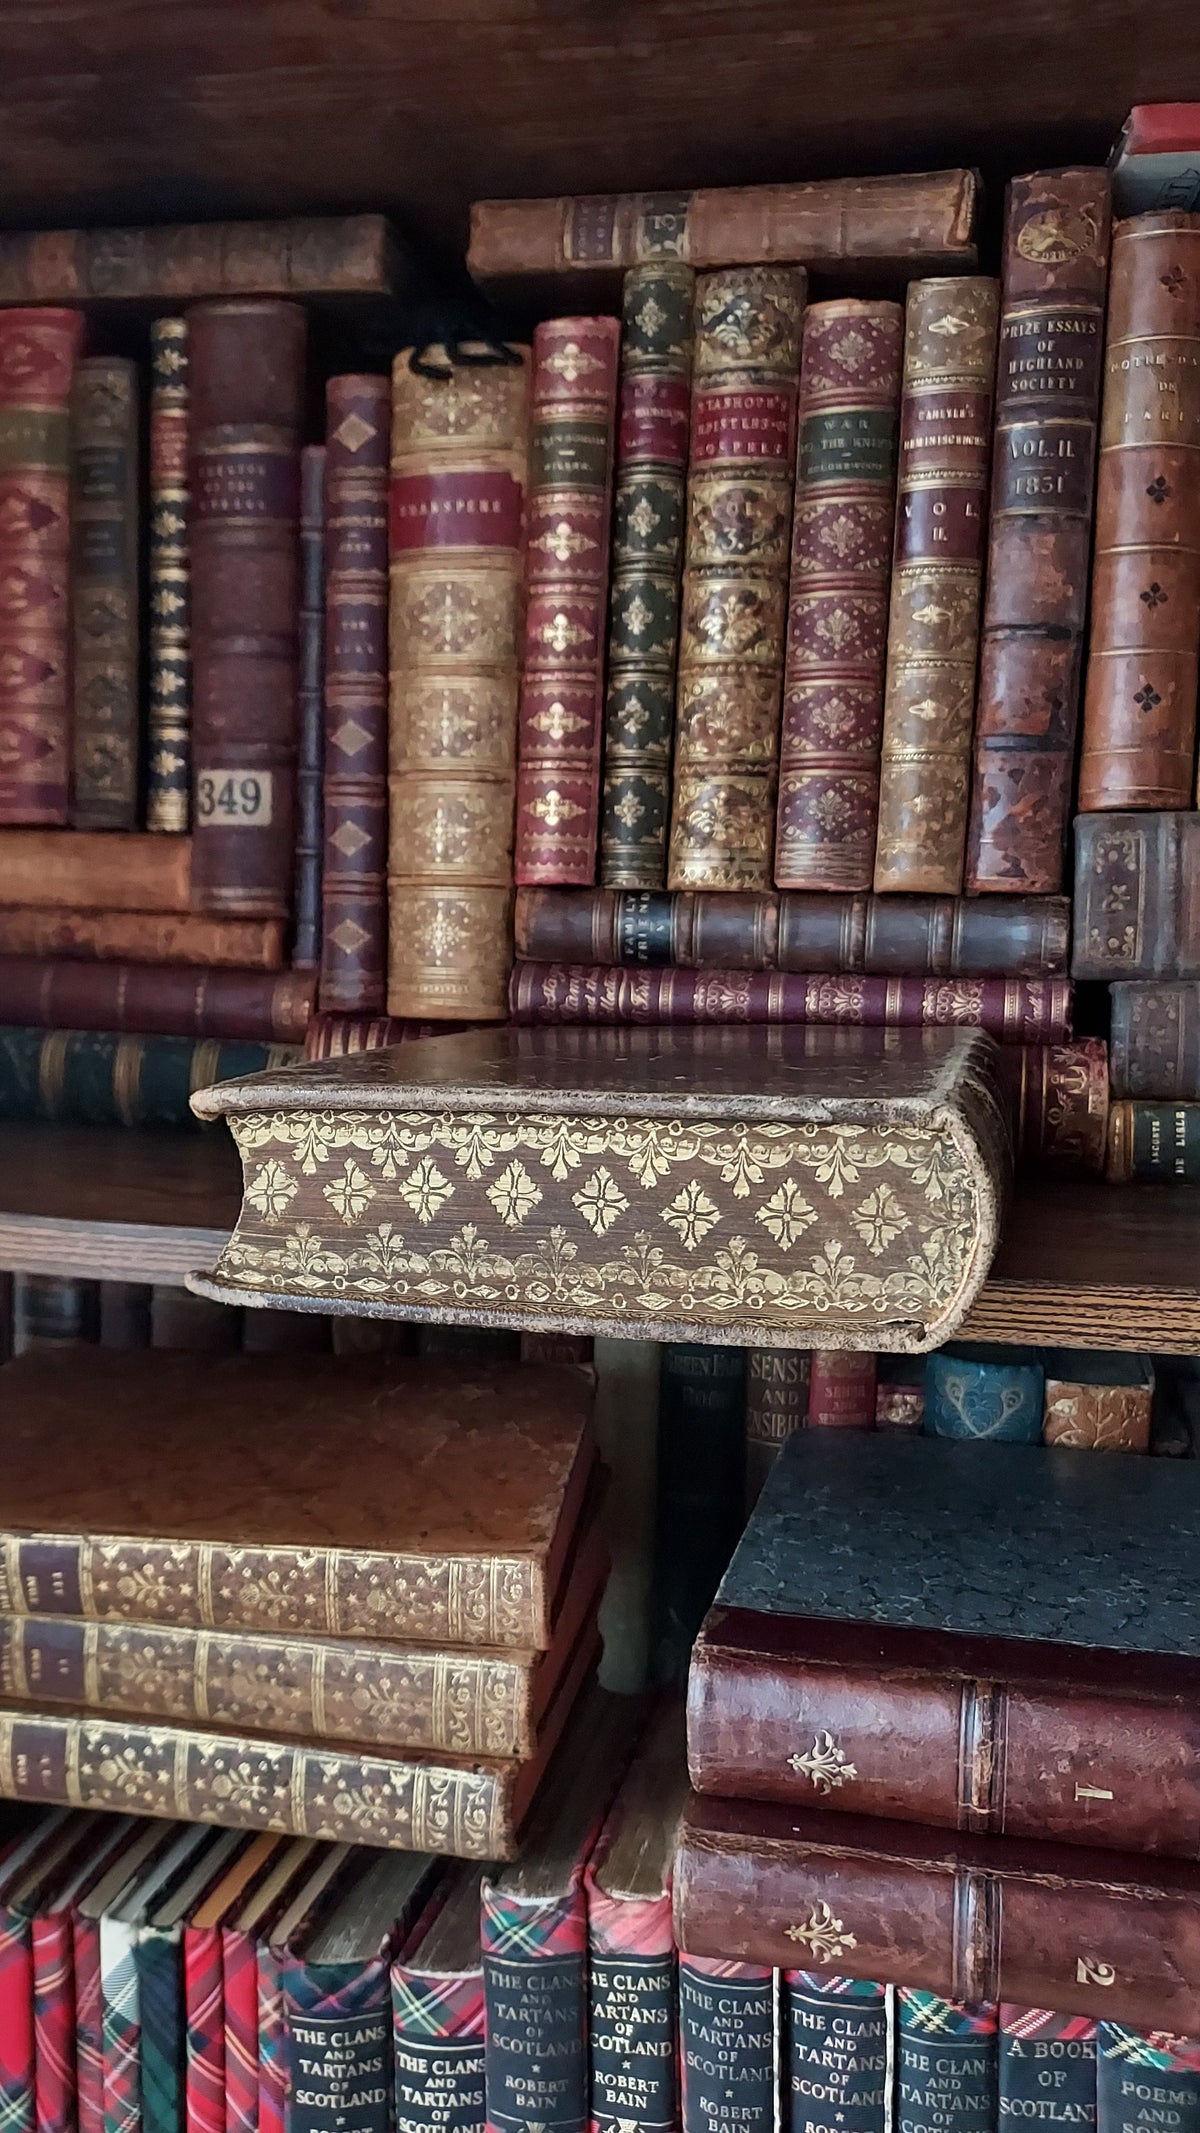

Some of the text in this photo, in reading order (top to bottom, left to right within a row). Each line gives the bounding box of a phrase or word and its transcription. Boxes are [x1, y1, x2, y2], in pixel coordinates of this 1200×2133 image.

[1002, 320, 1096, 339] PRIZE ESSAYS
[1037, 340, 1056, 352] OF
[1009, 357, 1084, 374] HIGHLAND
[1011, 377, 1076, 393] SOCIETY
[918, 403, 975, 421] CARLYLE'S
[199, 778, 262, 816] 349
[624, 895, 636, 955] FAMILY
[637, 892, 650, 960] FRIEND
[750, 1353, 810, 1383] SENSE
[762, 1388, 799, 1405] AND
[1074, 1781, 1114, 1802] 1
[489, 1969, 522, 1989] THE
[1076, 1956, 1116, 1986] 2
[591, 1971, 671, 1992] HE CLANS
[607, 1991, 639, 2003] AND
[682, 1982, 714, 2011] THE
[494, 2002, 578, 2024] TARTANS
[591, 2002, 668, 2024] ARTANS
[711, 2015, 744, 2029] AND
[791, 2007, 826, 2031] THE
[292, 2026, 387, 2047] THE CLANS
[525, 2026, 544, 2038] OF
[615, 2023, 634, 2037] OF
[687, 2018, 773, 2049] TARTANS
[590, 2032, 673, 2057] COTLAND
[823, 2036, 857, 2051] AND
[1006, 2039, 1098, 2059] A BOOK
[324, 2050, 356, 2061] AND
[397, 2051, 486, 2075] THE CLANS
[718, 2050, 738, 2063] OF
[794, 2043, 885, 2071] TARTANS
[298, 2057, 383, 2079] TARTANS
[935, 2059, 987, 2076] CLAN
[329, 2081, 349, 2092] OF
[425, 2077, 457, 2089] AND
[504, 2074, 569, 2093] ROBERT
[594, 2070, 660, 2094] ROBERT
[829, 2072, 850, 2086] OF
[926, 2077, 962, 2090] AND
[1038, 2070, 1068, 2087] OF
[295, 2088, 387, 2109] SCOTLAND
[401, 2085, 483, 2108] TARTANS
[516, 2093, 558, 2109] BAIN
[605, 2089, 648, 2109] BAIN
[899, 2082, 991, 2111] TARTANS
[1121, 2080, 1198, 2105] POEMS
[431, 2110, 451, 2122] OF
[699, 2095, 763, 2120] ROBERT
[1137, 2107, 1181, 2125] AND
[708, 2118, 750, 2133] BAIN
[932, 2112, 954, 2126] OF
